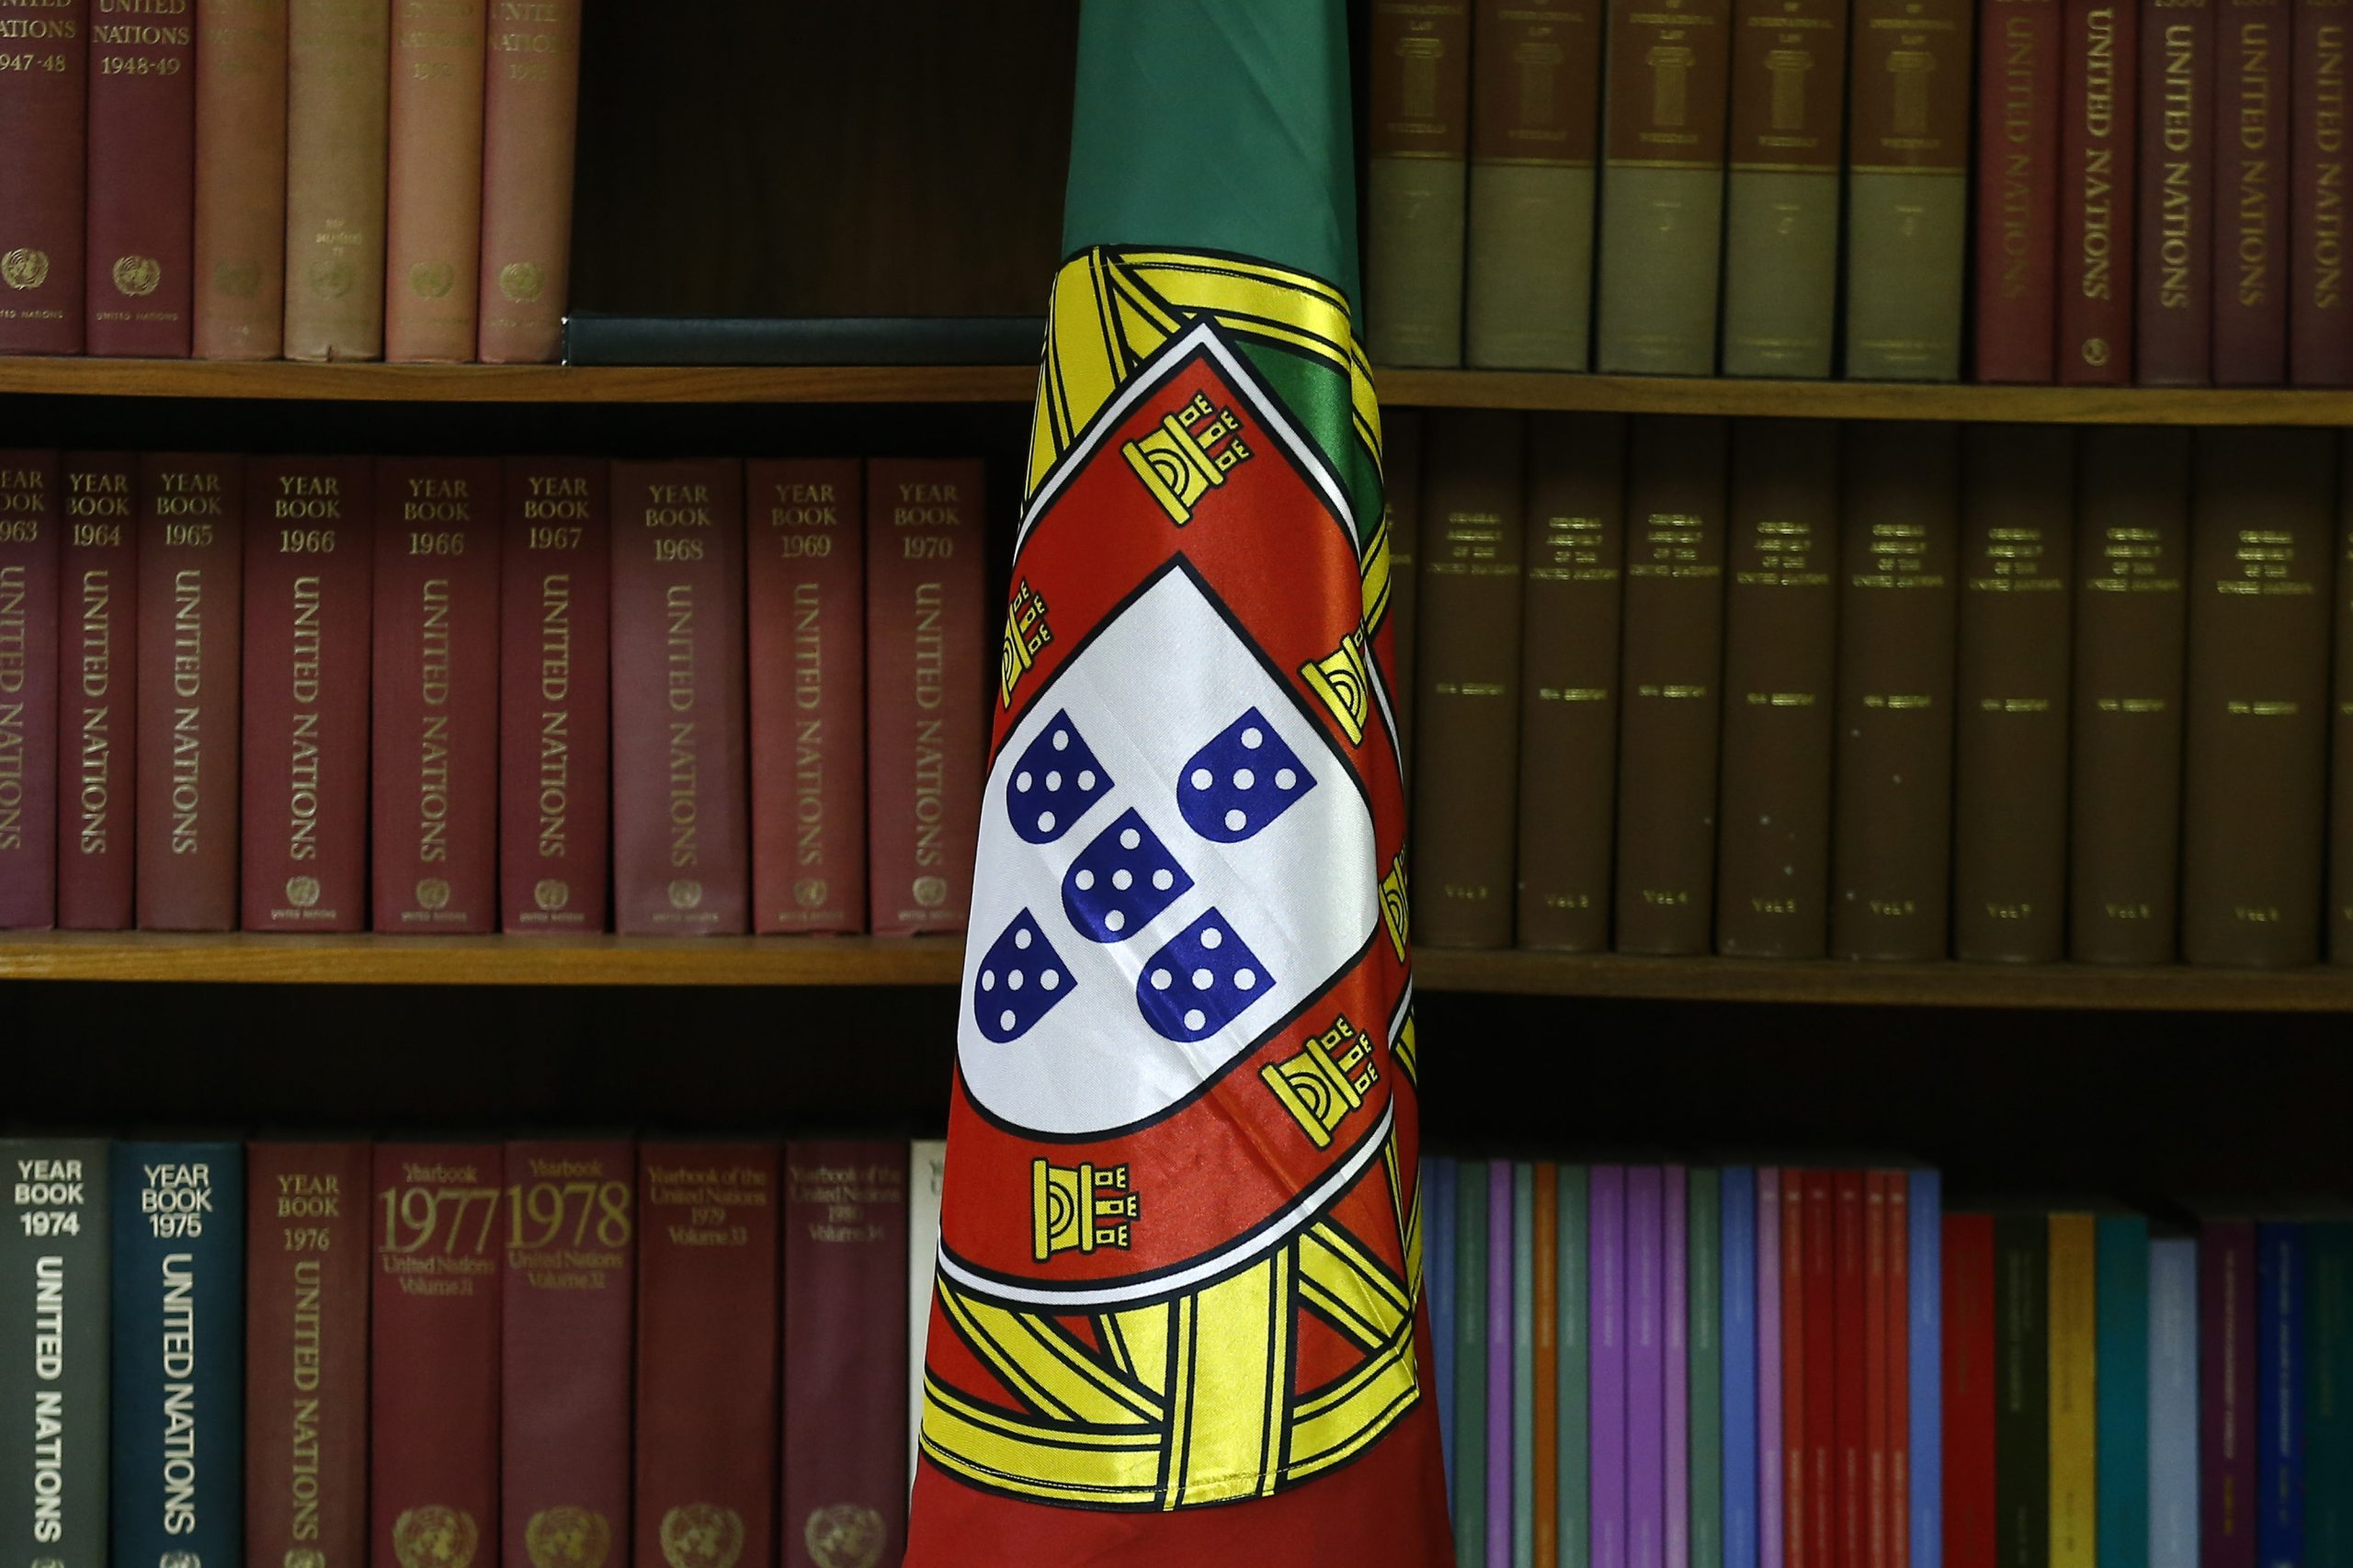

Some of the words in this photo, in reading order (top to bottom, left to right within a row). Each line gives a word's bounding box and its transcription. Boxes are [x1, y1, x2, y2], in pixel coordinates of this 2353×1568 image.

[99, 0, 186, 14] UNITED
[0, 20, 75, 39] ATIONS
[93, 26, 191, 45] NATIONS
[0, 54, 66, 73] 947-48
[102, 57, 181, 75] 1948-49
[2086, 6, 2115, 139] UNITED
[2163, 24, 2195, 153] UNITED
[2240, 22, 2270, 152] UNITED
[2316, 25, 2346, 153] UNITED
[2082, 147, 2112, 301] NATIONS
[2161, 161, 2193, 310] NATIONS
[2238, 159, 2268, 308] NATIONS
[2314, 163, 2346, 310] NATIONS
[1, 471, 44, 489] EAR
[69, 473, 129, 493] YEAR
[161, 473, 222, 492] YEAR
[279, 476, 339, 495] YEAR
[408, 479, 469, 497] YEAR
[528, 477, 588, 496] YEAR
[0, 493, 45, 511] OOK
[648, 484, 710, 504] YEAR
[775, 483, 835, 503] YEAR
[899, 483, 959, 502] YEAR
[65, 496, 130, 516] BOOK
[156, 496, 222, 516] BOOK
[276, 499, 341, 518] BOOK
[404, 502, 471, 521] BOOK
[525, 500, 589, 519] BOOK
[771, 506, 837, 526] BOOK
[894, 506, 961, 526] BOOK
[645, 508, 711, 528] BOOK
[0, 520, 39, 542] 963
[73, 524, 122, 546] 1964
[165, 524, 214, 546] 1965
[279, 529, 335, 552] 1966
[529, 527, 583, 549] 1967
[408, 532, 465, 555] 1966
[654, 539, 704, 562] 1968
[781, 535, 832, 558] 1969
[903, 537, 953, 560] 1970
[0, 565, 25, 694] UNITED
[84, 570, 108, 698] UNITED
[175, 569, 201, 699] UNITED
[292, 575, 321, 703] UNITED
[541, 574, 570, 701] UNITED
[422, 578, 449, 706] UNITED
[666, 585, 695, 712] UNITED
[793, 583, 821, 710] UNITED
[915, 582, 942, 710] UNITED
[0, 702, 23, 850] NATIONS
[81, 706, 108, 855] NATIONS
[172, 707, 200, 855] NATIONS
[290, 712, 319, 861] NATIONS
[539, 710, 568, 858] NATIONS
[420, 715, 449, 864] NATIONS
[669, 722, 698, 869] NATIONS
[795, 720, 824, 866] NATIONS
[915, 719, 945, 868] NATIONS
[17, 1160, 83, 1181] YEAR
[143, 1164, 209, 1187] YEAR
[403, 1163, 477, 1183] Yearbook
[529, 1158, 602, 1177] Yearbook
[648, 1165, 717, 1185] Yearbook
[721, 1166, 739, 1185] of
[741, 1167, 766, 1185] the
[15, 1183, 84, 1205] BOOK
[278, 1175, 340, 1194] YEAR
[142, 1188, 213, 1213] BOOK
[278, 1197, 340, 1218] BOOK
[651, 1187, 701, 1205] United
[704, 1188, 767, 1206] Nations
[20, 1212, 80, 1236] 1974
[149, 1213, 202, 1238] 1975
[378, 1186, 500, 1255] 1977
[506, 1181, 631, 1248] 1978
[691, 1207, 725, 1226] 1979
[283, 1227, 329, 1251] 1976
[668, 1226, 727, 1245] Volume
[382, 1254, 435, 1273] United
[438, 1255, 494, 1274] Nations
[508, 1251, 562, 1269] United
[564, 1251, 624, 1269] Nations
[35, 1256, 63, 1381] UNITED
[162, 1253, 194, 1379] UNITED
[293, 1261, 321, 1392] UNITED
[34, 1392, 63, 1543] NATIONS
[164, 1383, 196, 1536] NATIONS
[292, 1398, 320, 1541] NATIONS
